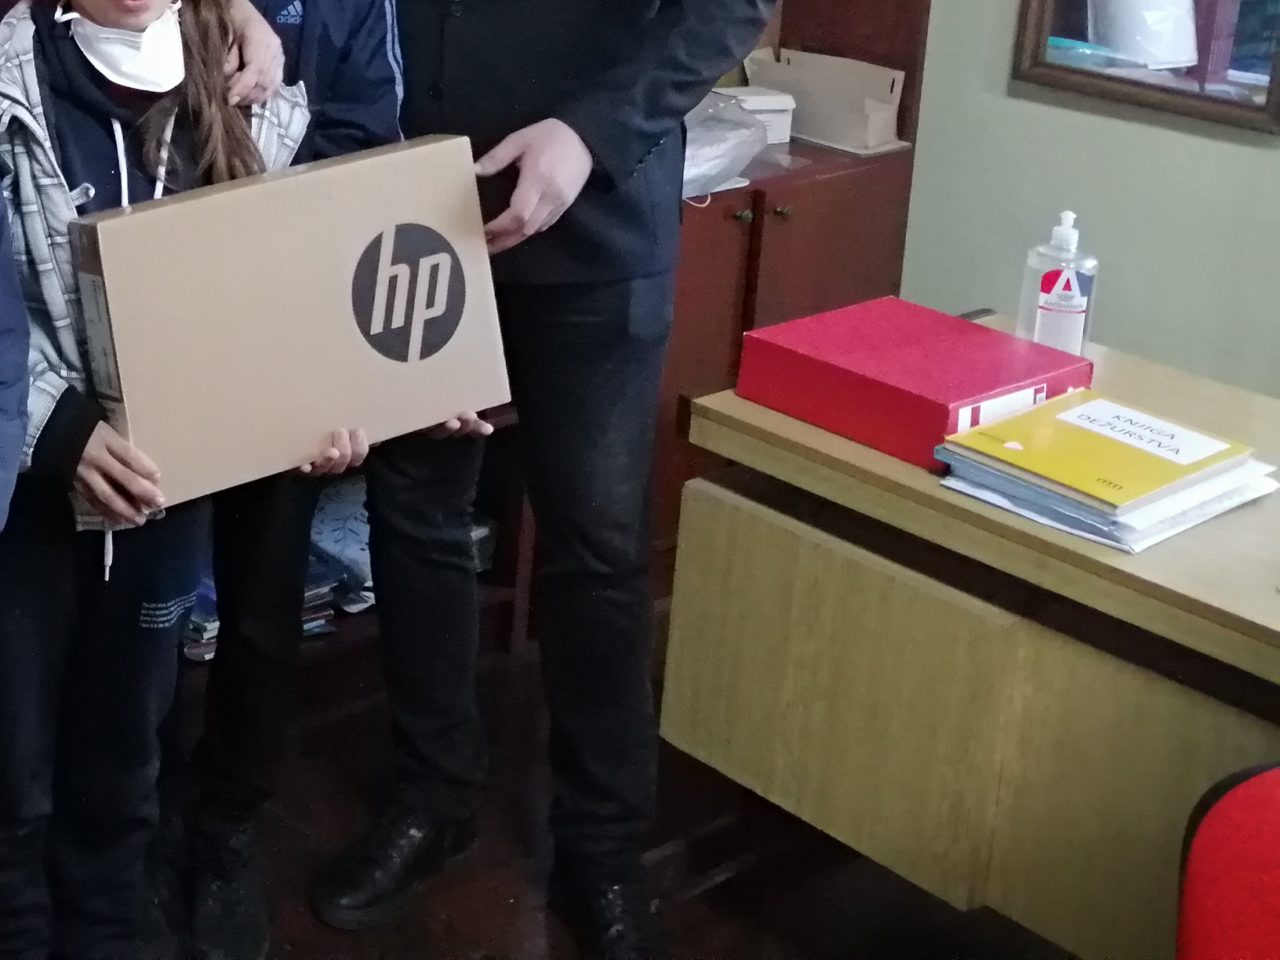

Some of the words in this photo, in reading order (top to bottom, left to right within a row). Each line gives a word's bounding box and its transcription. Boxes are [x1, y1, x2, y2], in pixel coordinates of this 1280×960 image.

[276, 14, 303, 25] adid
[370, 224, 451, 362] hp
[1112, 414, 1175, 440] KNJIGA
